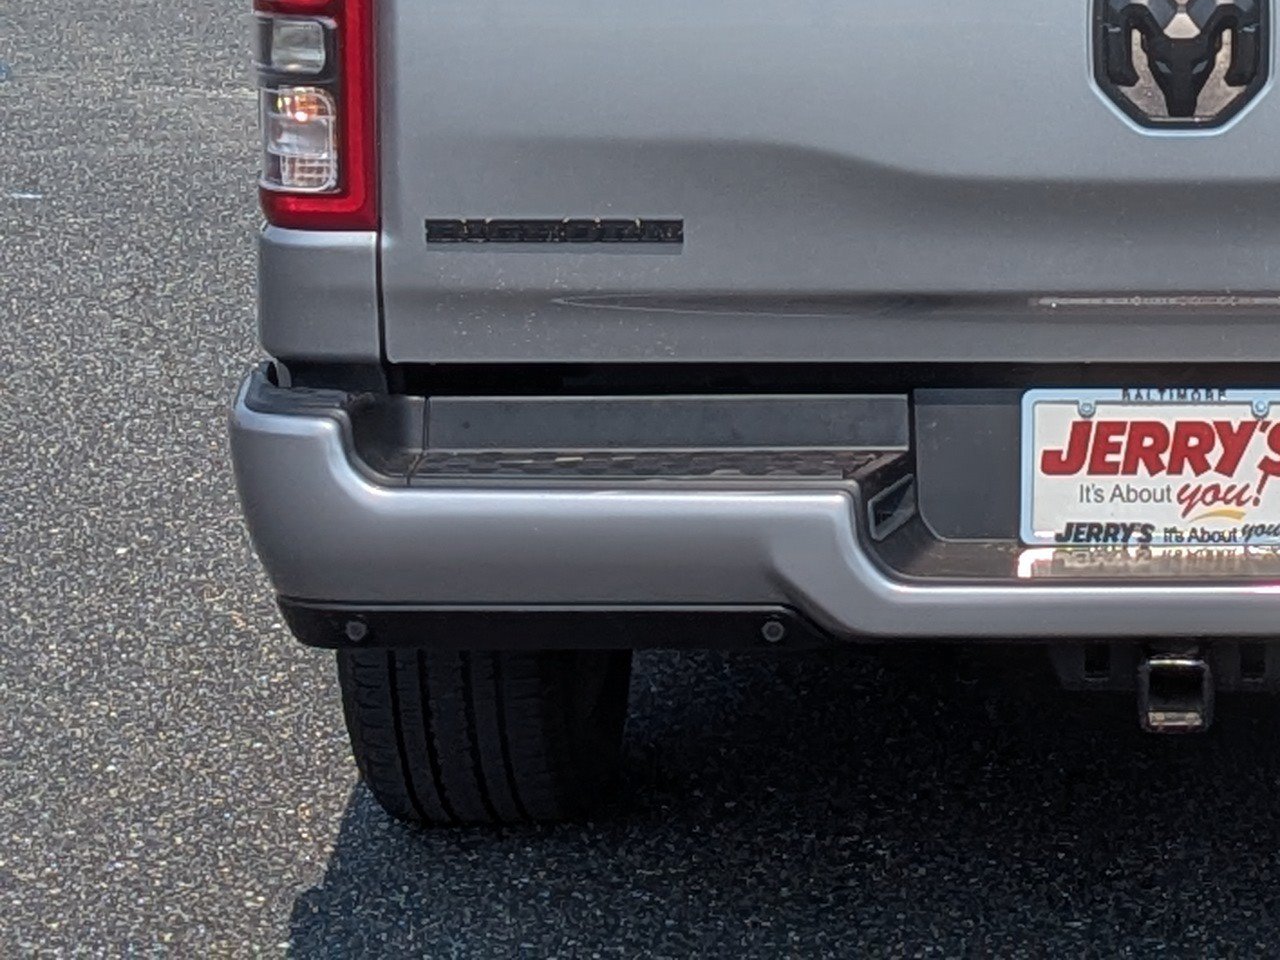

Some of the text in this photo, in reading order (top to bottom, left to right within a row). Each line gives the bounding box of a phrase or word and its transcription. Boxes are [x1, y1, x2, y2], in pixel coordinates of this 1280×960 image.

[1079, 471, 1270, 520] It's About you!
[1054, 522, 1155, 543] JERRY'S
[1163, 526, 1184, 544] It's
[1187, 525, 1238, 544] About
